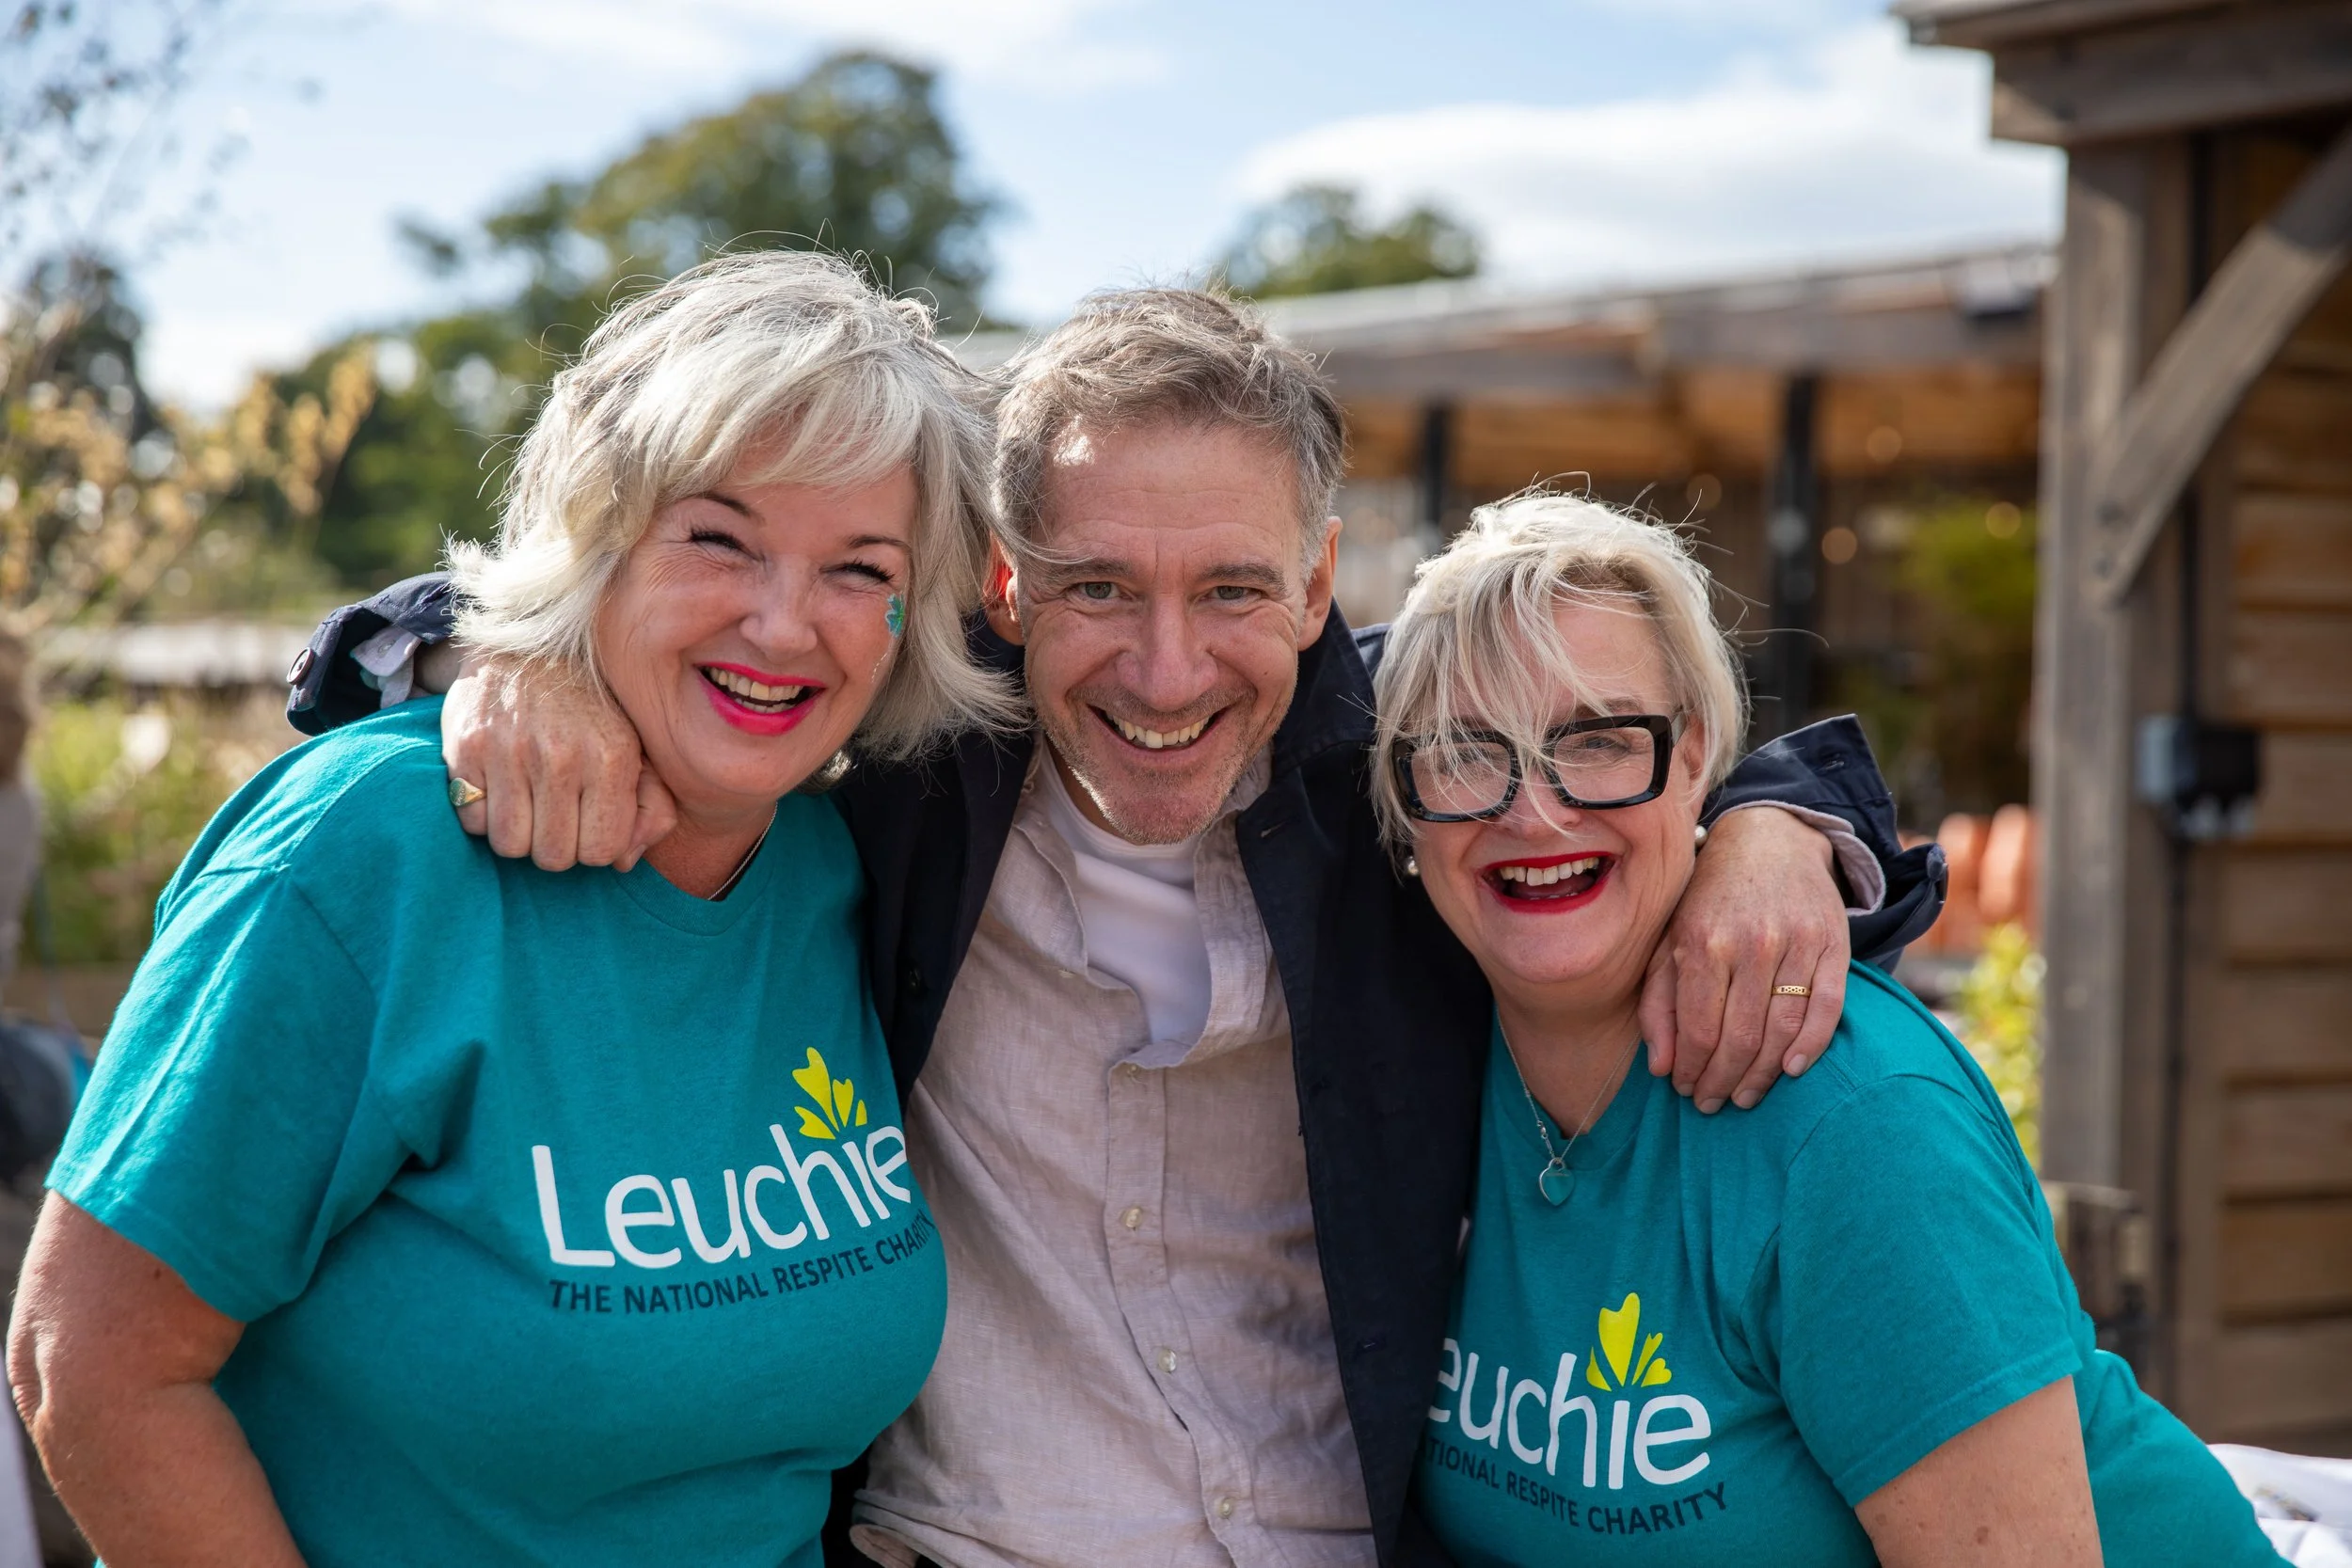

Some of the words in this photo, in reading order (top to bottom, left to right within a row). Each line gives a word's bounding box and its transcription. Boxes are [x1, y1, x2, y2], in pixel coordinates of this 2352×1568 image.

[532, 1124, 911, 1269] Leuchie
[548, 1279, 612, 1313] THE
[624, 1272, 769, 1314] NATIONAL
[771, 1246, 874, 1294] RESPITE
[875, 1208, 936, 1264] CHARITY
[1427, 1338, 1711, 1490] euchie
[1427, 1438, 1500, 1489] TIONAL
[1507, 1470, 1580, 1527] RESPITE
[1587, 1481, 1727, 1534] CHARITY
